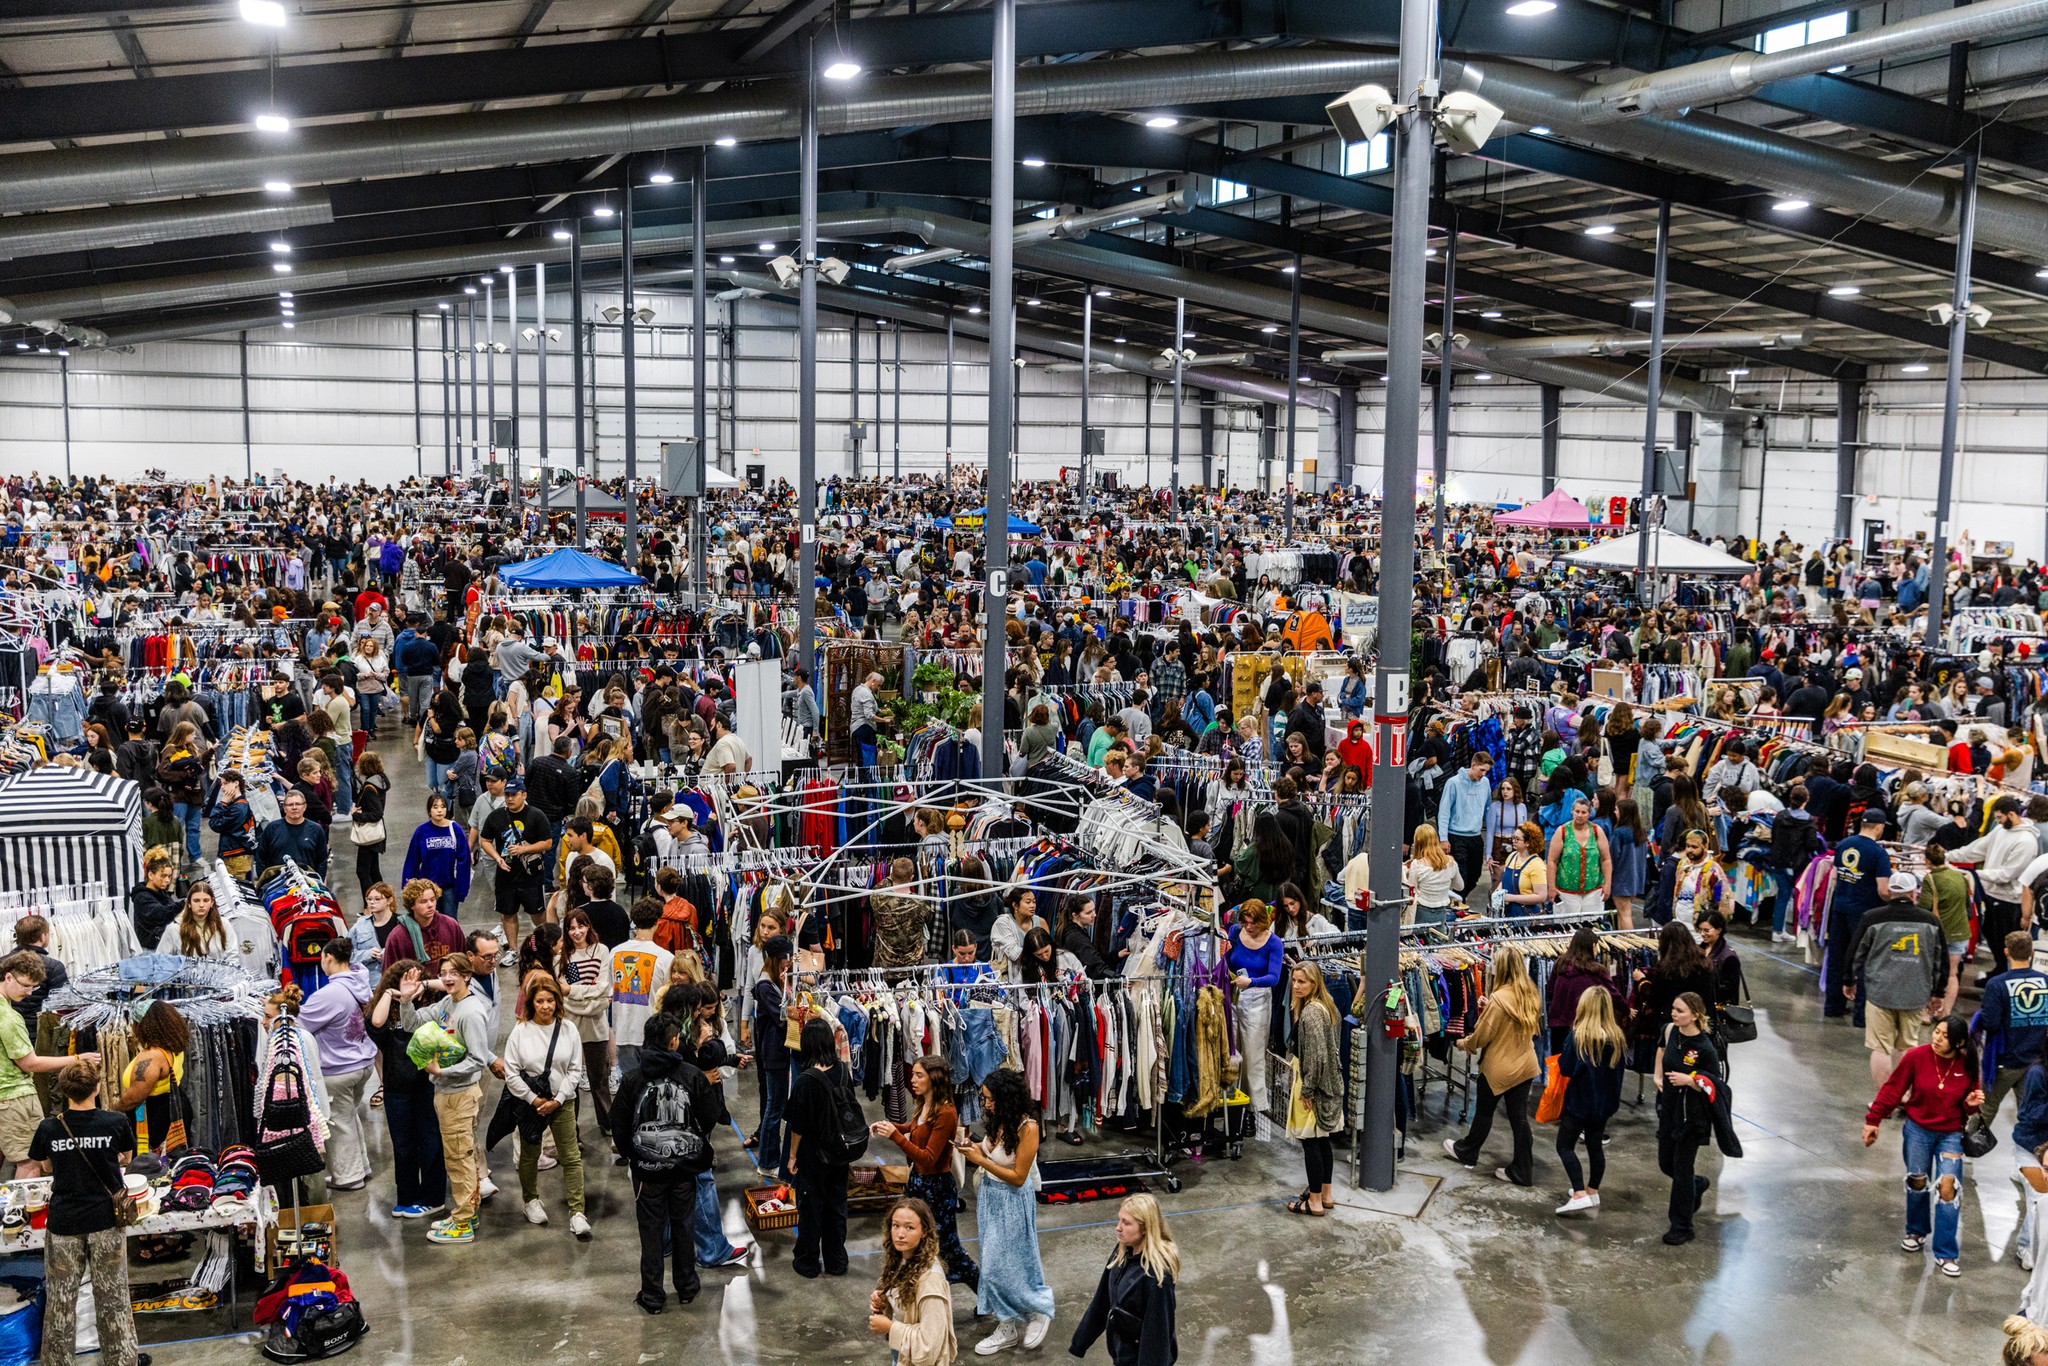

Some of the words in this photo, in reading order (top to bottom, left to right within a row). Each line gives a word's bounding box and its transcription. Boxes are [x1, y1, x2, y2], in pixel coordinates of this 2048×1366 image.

[628, 479, 635, 493] F
[802, 524, 815, 544] D
[989, 570, 1006, 597] C
[1387, 673, 1409, 714] B
[51, 1135, 113, 1153] SECURITY
[323, 1331, 349, 1347] SONY
